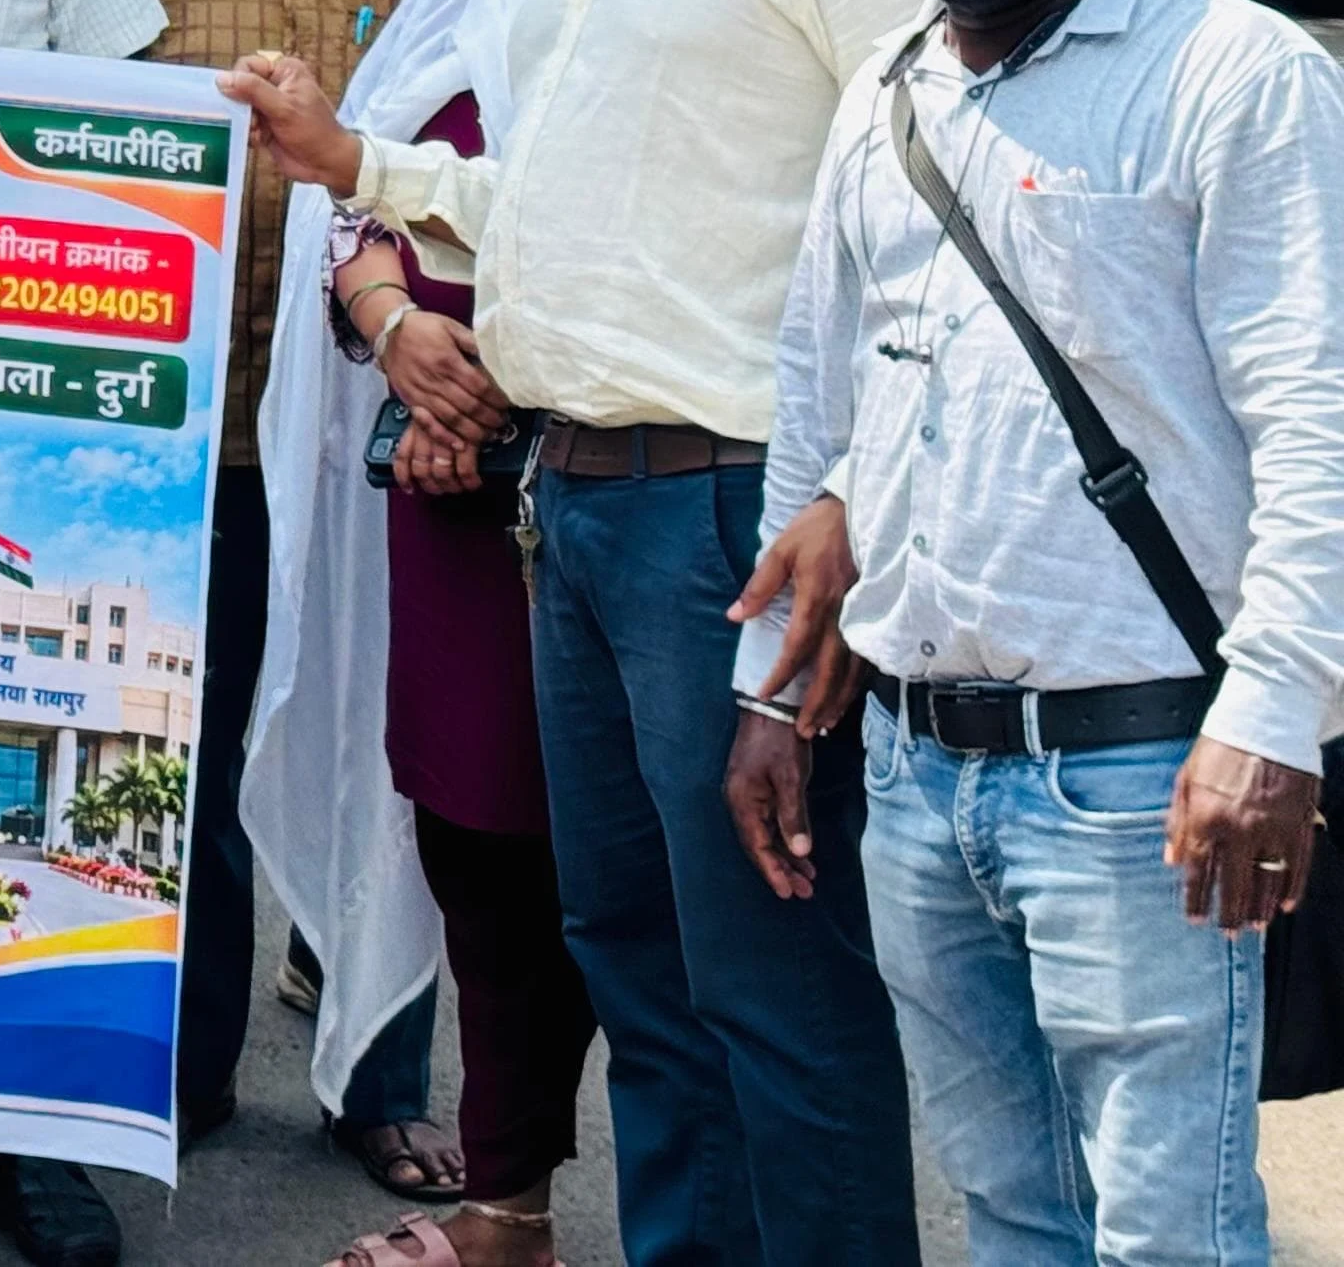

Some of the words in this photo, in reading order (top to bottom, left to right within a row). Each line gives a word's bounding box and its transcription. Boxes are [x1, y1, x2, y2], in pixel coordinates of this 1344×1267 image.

[34, 122, 205, 173] कर्मचारीहित
[65, 238, 152, 274] क्रमांक
[95, 360, 157, 418] दुर्ग
